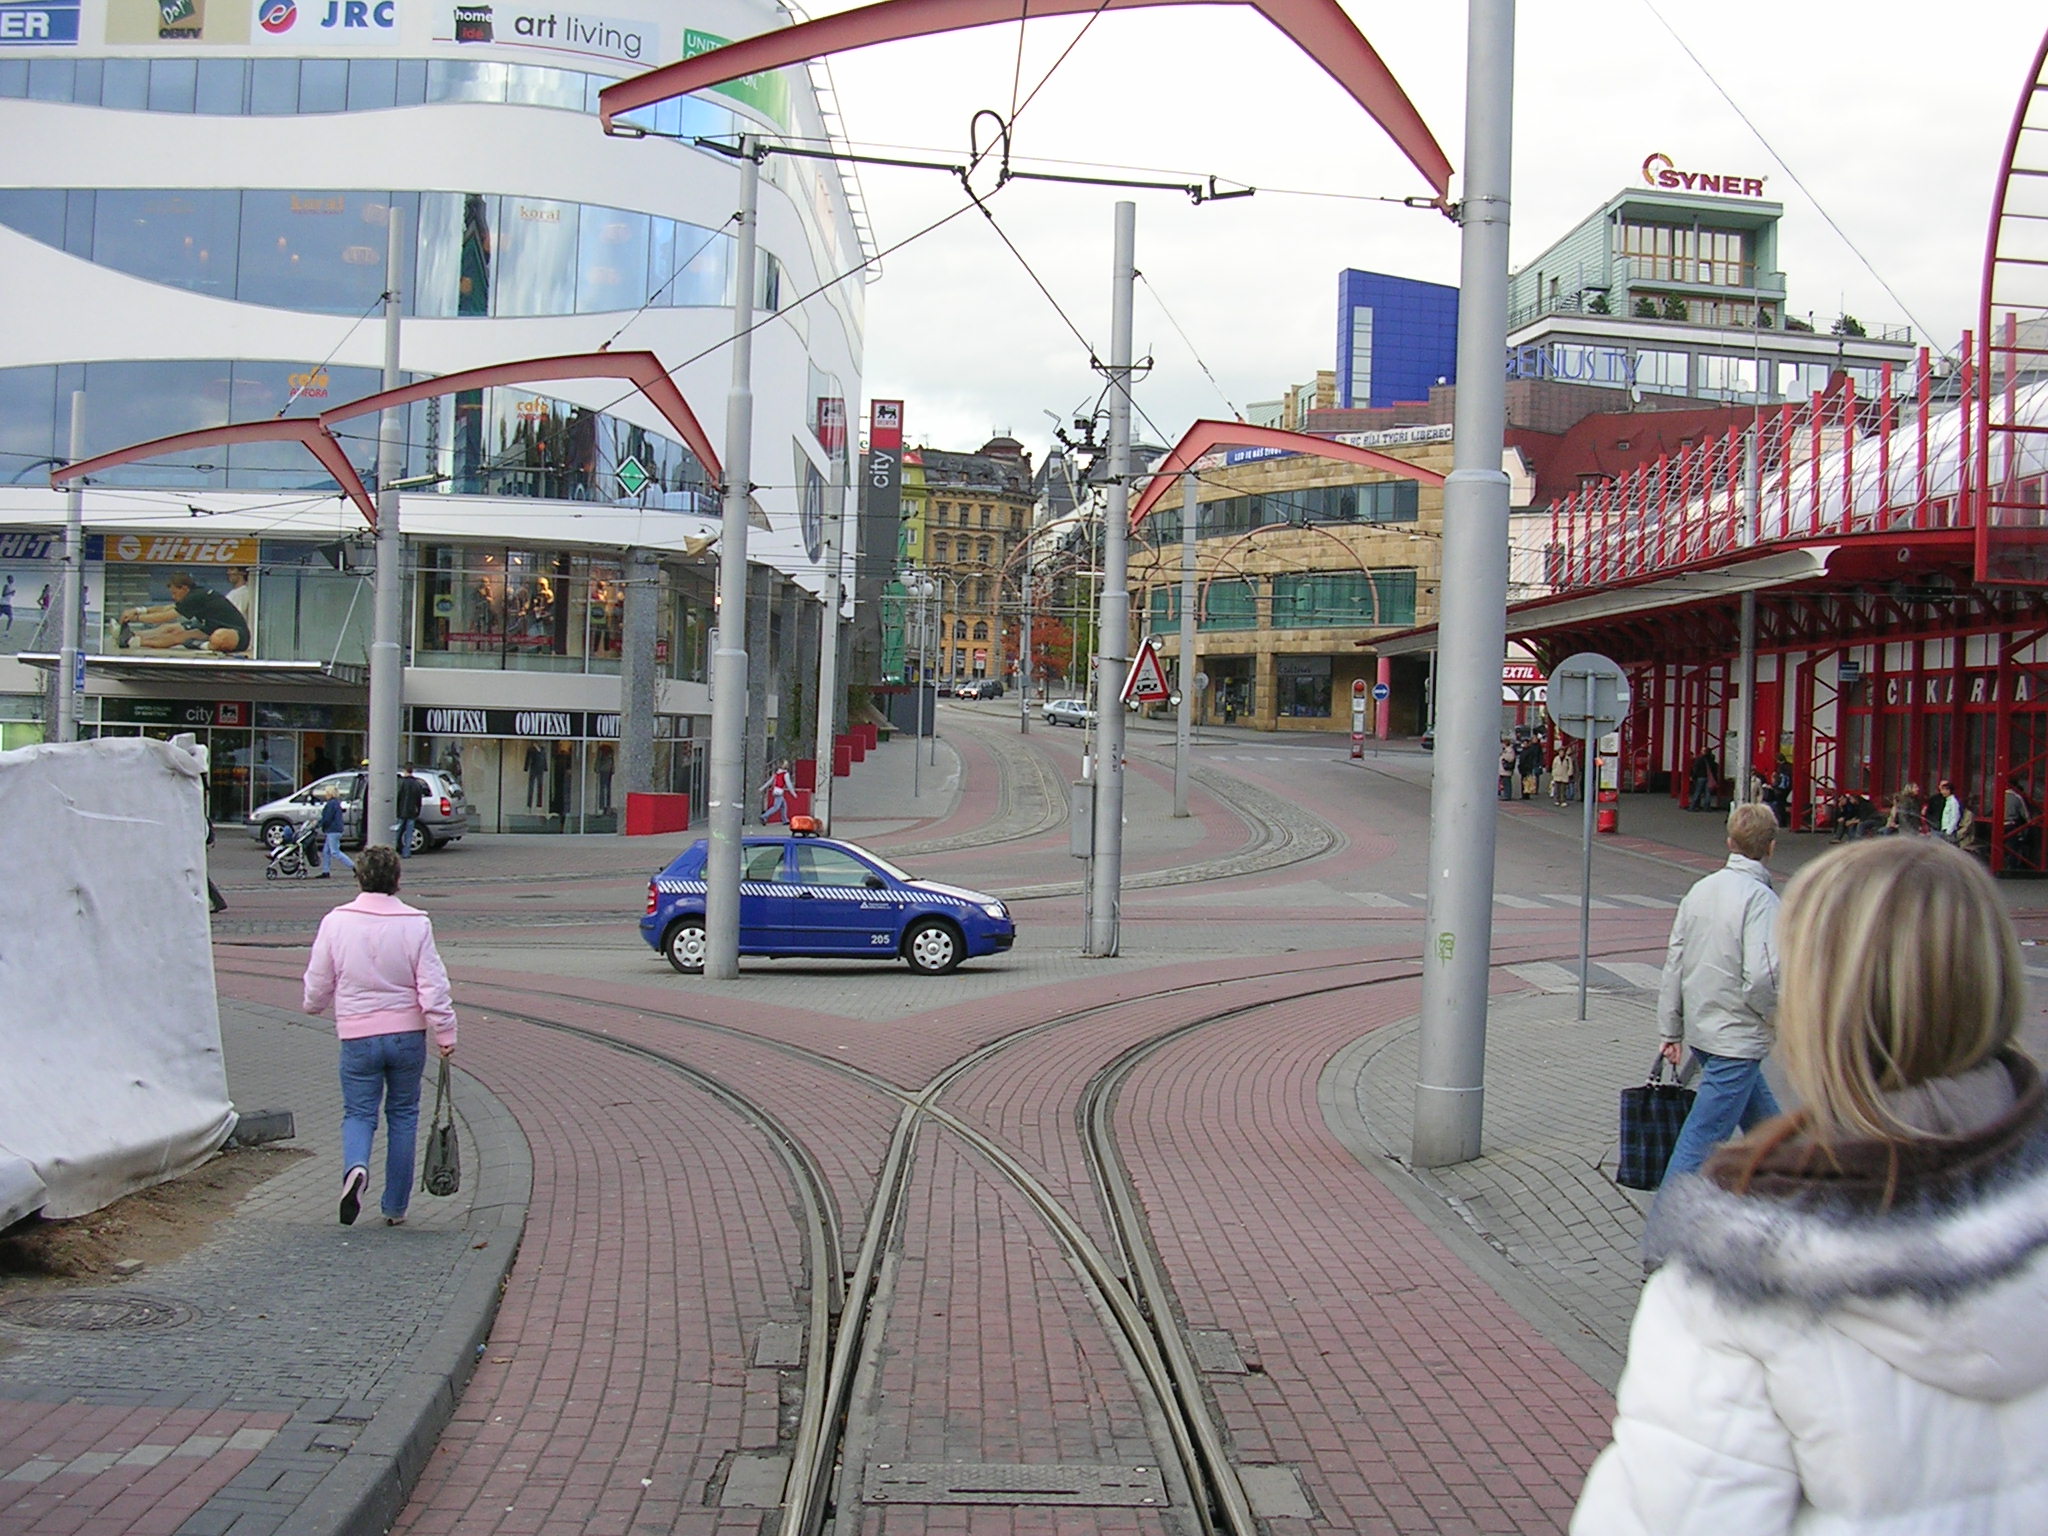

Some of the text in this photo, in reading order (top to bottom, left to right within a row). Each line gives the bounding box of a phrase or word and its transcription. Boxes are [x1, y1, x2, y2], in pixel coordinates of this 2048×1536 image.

[320, 1, 394, 28] JRC
[455, 9, 492, 22] home
[515, 14, 641, 58] art living
[1659, 169, 1763, 197] SYNER
[1411, 428, 1451, 440] LIBEREC
[869, 450, 895, 488] city
[0, 534, 53, 557] HI-T
[146, 538, 239, 561] HI-TEC
[1502, 666, 1534, 679] EXTIL
[185, 706, 213, 724] city
[426, 709, 487, 733] COMTESSA
[515, 712, 571, 735] COMTESSA
[597, 714, 620, 737] COMT
[871, 935, 890, 944] 205
